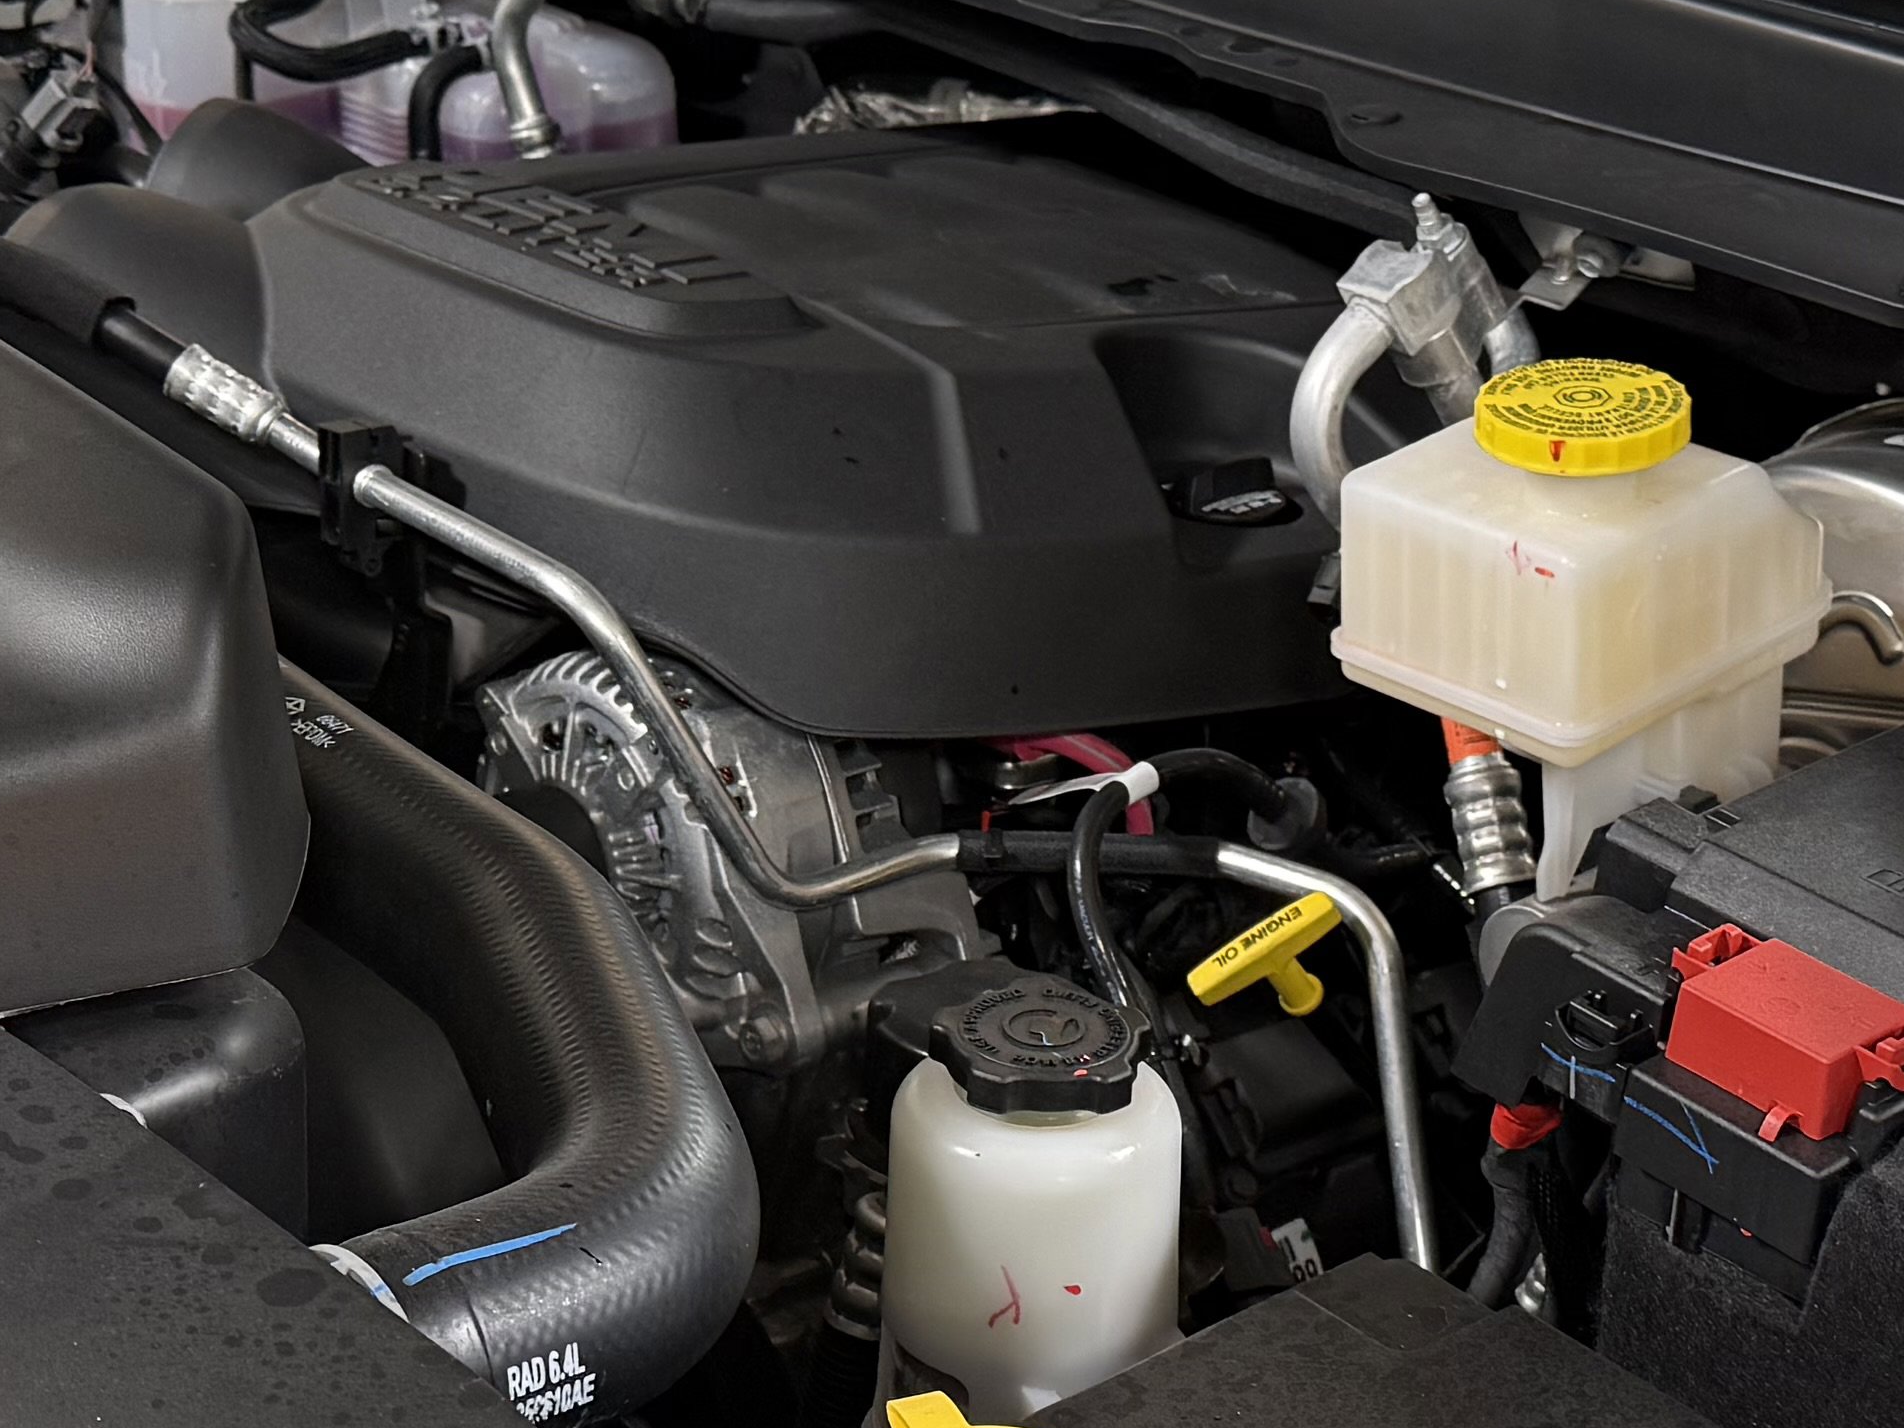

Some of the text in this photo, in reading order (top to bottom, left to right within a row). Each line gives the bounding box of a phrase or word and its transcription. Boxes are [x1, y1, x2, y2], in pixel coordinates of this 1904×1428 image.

[1211, 906, 1303, 968] ENGINE OIL
[507, 1341, 586, 1402] RAD 6.4L
